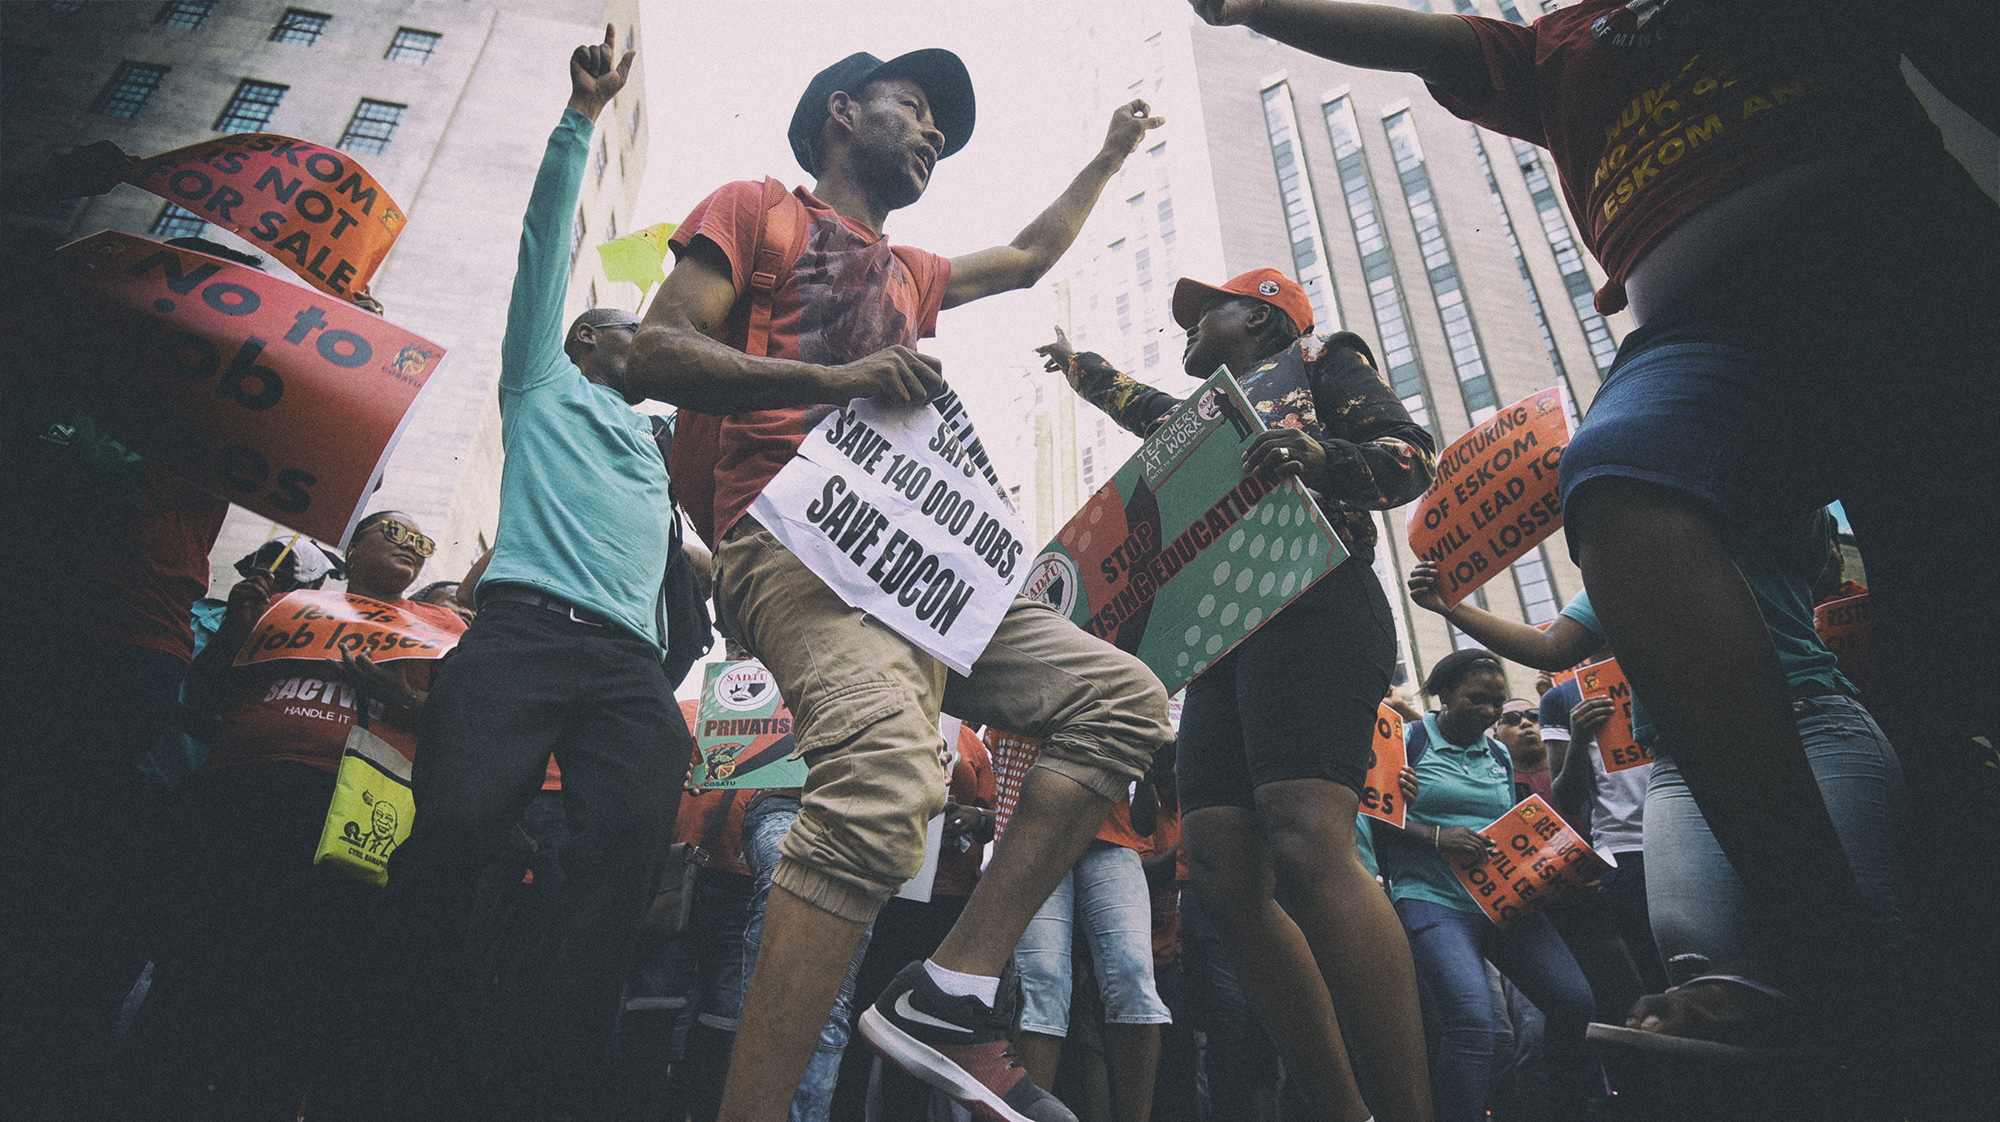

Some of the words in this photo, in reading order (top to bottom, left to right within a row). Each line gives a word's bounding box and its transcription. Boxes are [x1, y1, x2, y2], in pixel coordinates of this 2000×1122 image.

[201, 147, 250, 175] IS
[253, 165, 359, 241] NOT
[234, 133, 378, 217] ESKOM
[1603, 113, 1725, 221] ESKOM
[140, 159, 246, 222] FOR
[249, 210, 359, 296] SALE
[123, 250, 262, 316] No
[283, 305, 374, 369] to
[928, 421, 977, 478] SAYS
[1137, 406, 1196, 463] TEACHERS
[1145, 450, 1162, 477] AT
[1165, 414, 1203, 454] WORK
[825, 409, 893, 477] SAVE
[881, 453, 932, 502] 140
[920, 479, 976, 537] 000
[962, 511, 1024, 587] JOBS,
[1421, 522, 1472, 564] WILL
[1470, 475, 1526, 532] LEAD
[1527, 444, 1563, 482] TO
[1423, 496, 1451, 530] OF
[1453, 430, 1539, 506] ESKOM
[805, 474, 891, 568] SAVE
[866, 527, 976, 638] EDCON
[1099, 520, 1154, 585] STOP
[1146, 472, 1285, 590] EDUCATION
[1447, 549, 1490, 594] JOB
[1487, 482, 1564, 559] LOSSE
[245, 622, 316, 663] job
[323, 621, 444, 652] losses
[726, 672, 768, 683] SADTU
[283, 705, 336, 722] HANDLE
[337, 712, 352, 725] IT
[703, 780, 737, 788] COSATU
[1459, 860, 1498, 898] JOB
[1510, 833, 1540, 859] OF
